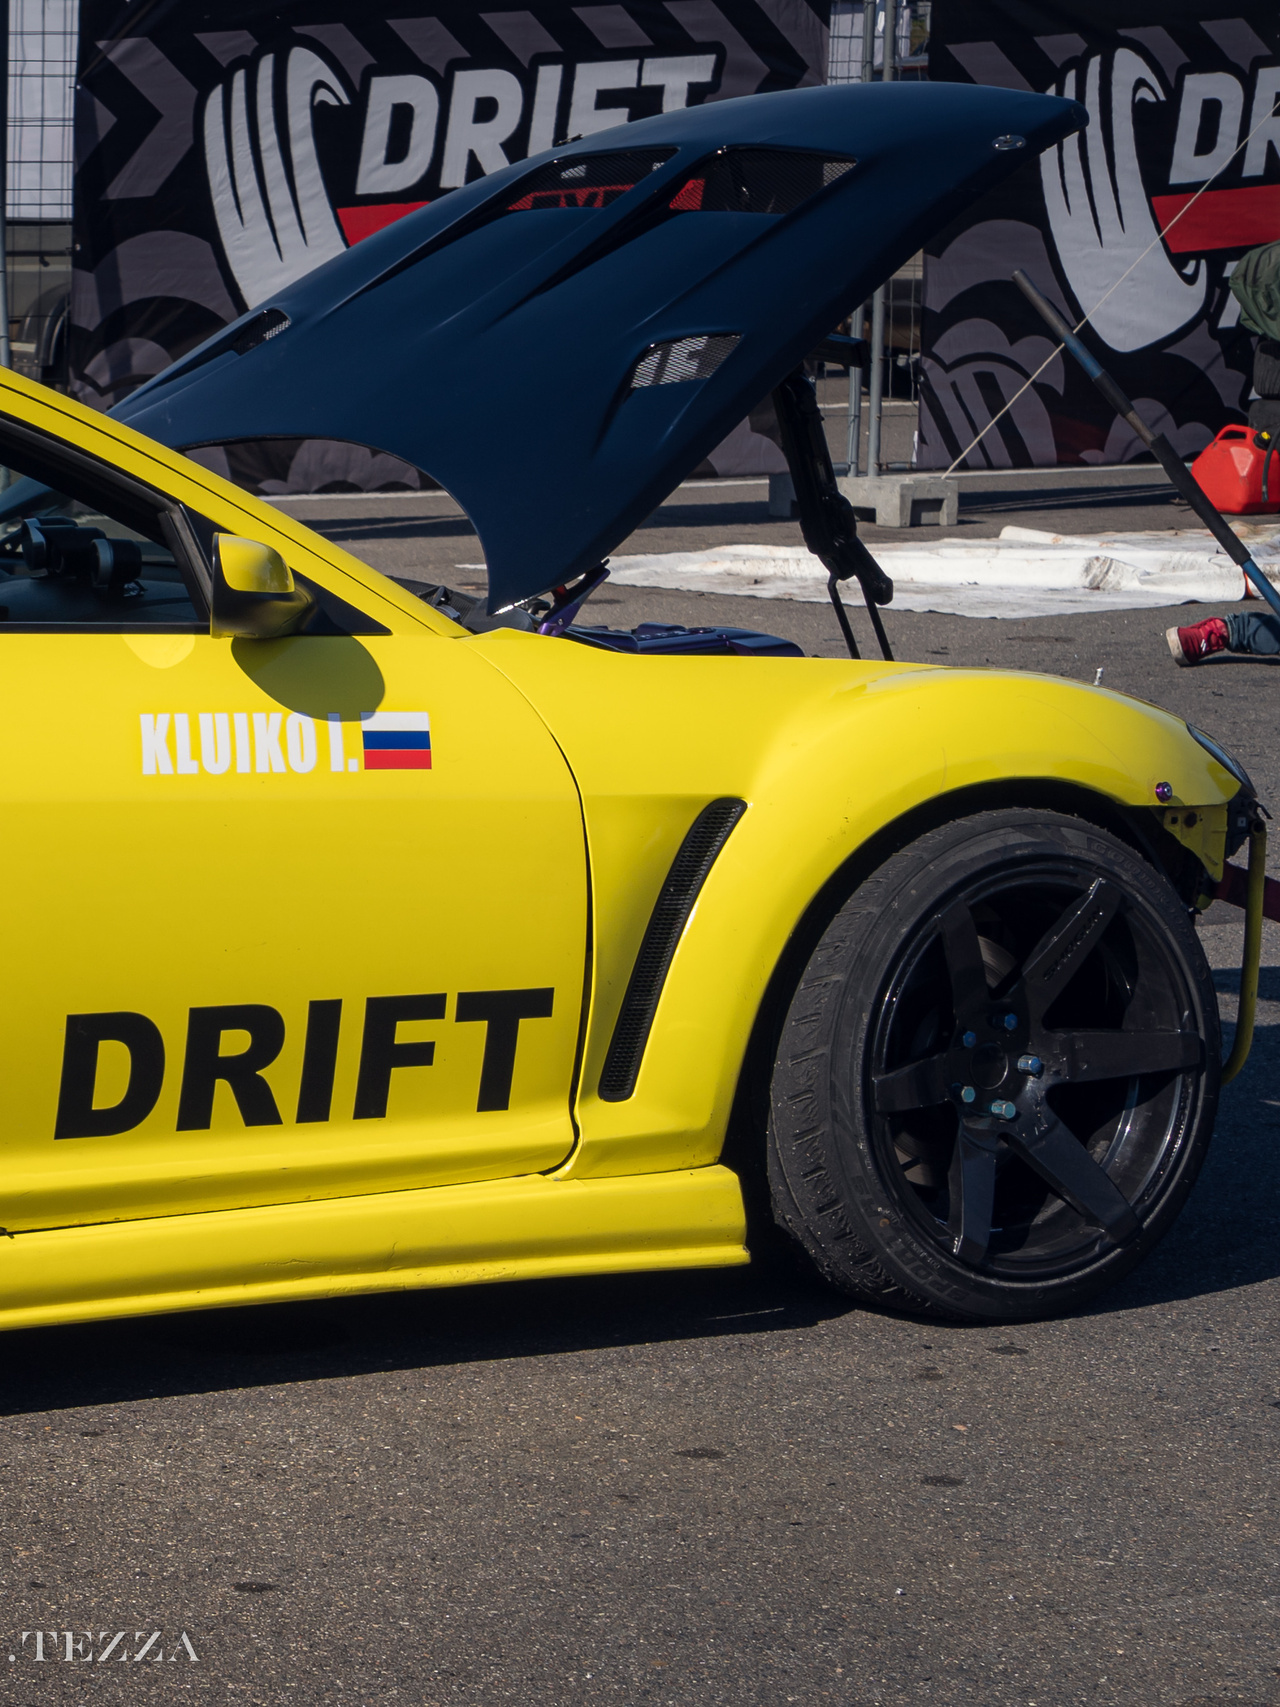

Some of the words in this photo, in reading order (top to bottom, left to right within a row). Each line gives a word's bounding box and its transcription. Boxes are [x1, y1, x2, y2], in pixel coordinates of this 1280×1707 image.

[355, 54, 717, 195] DRIFT
[139, 711, 318, 775] KLUIKO
[327, 711, 358, 773] I.
[53, 987, 554, 1142] DRIFT
